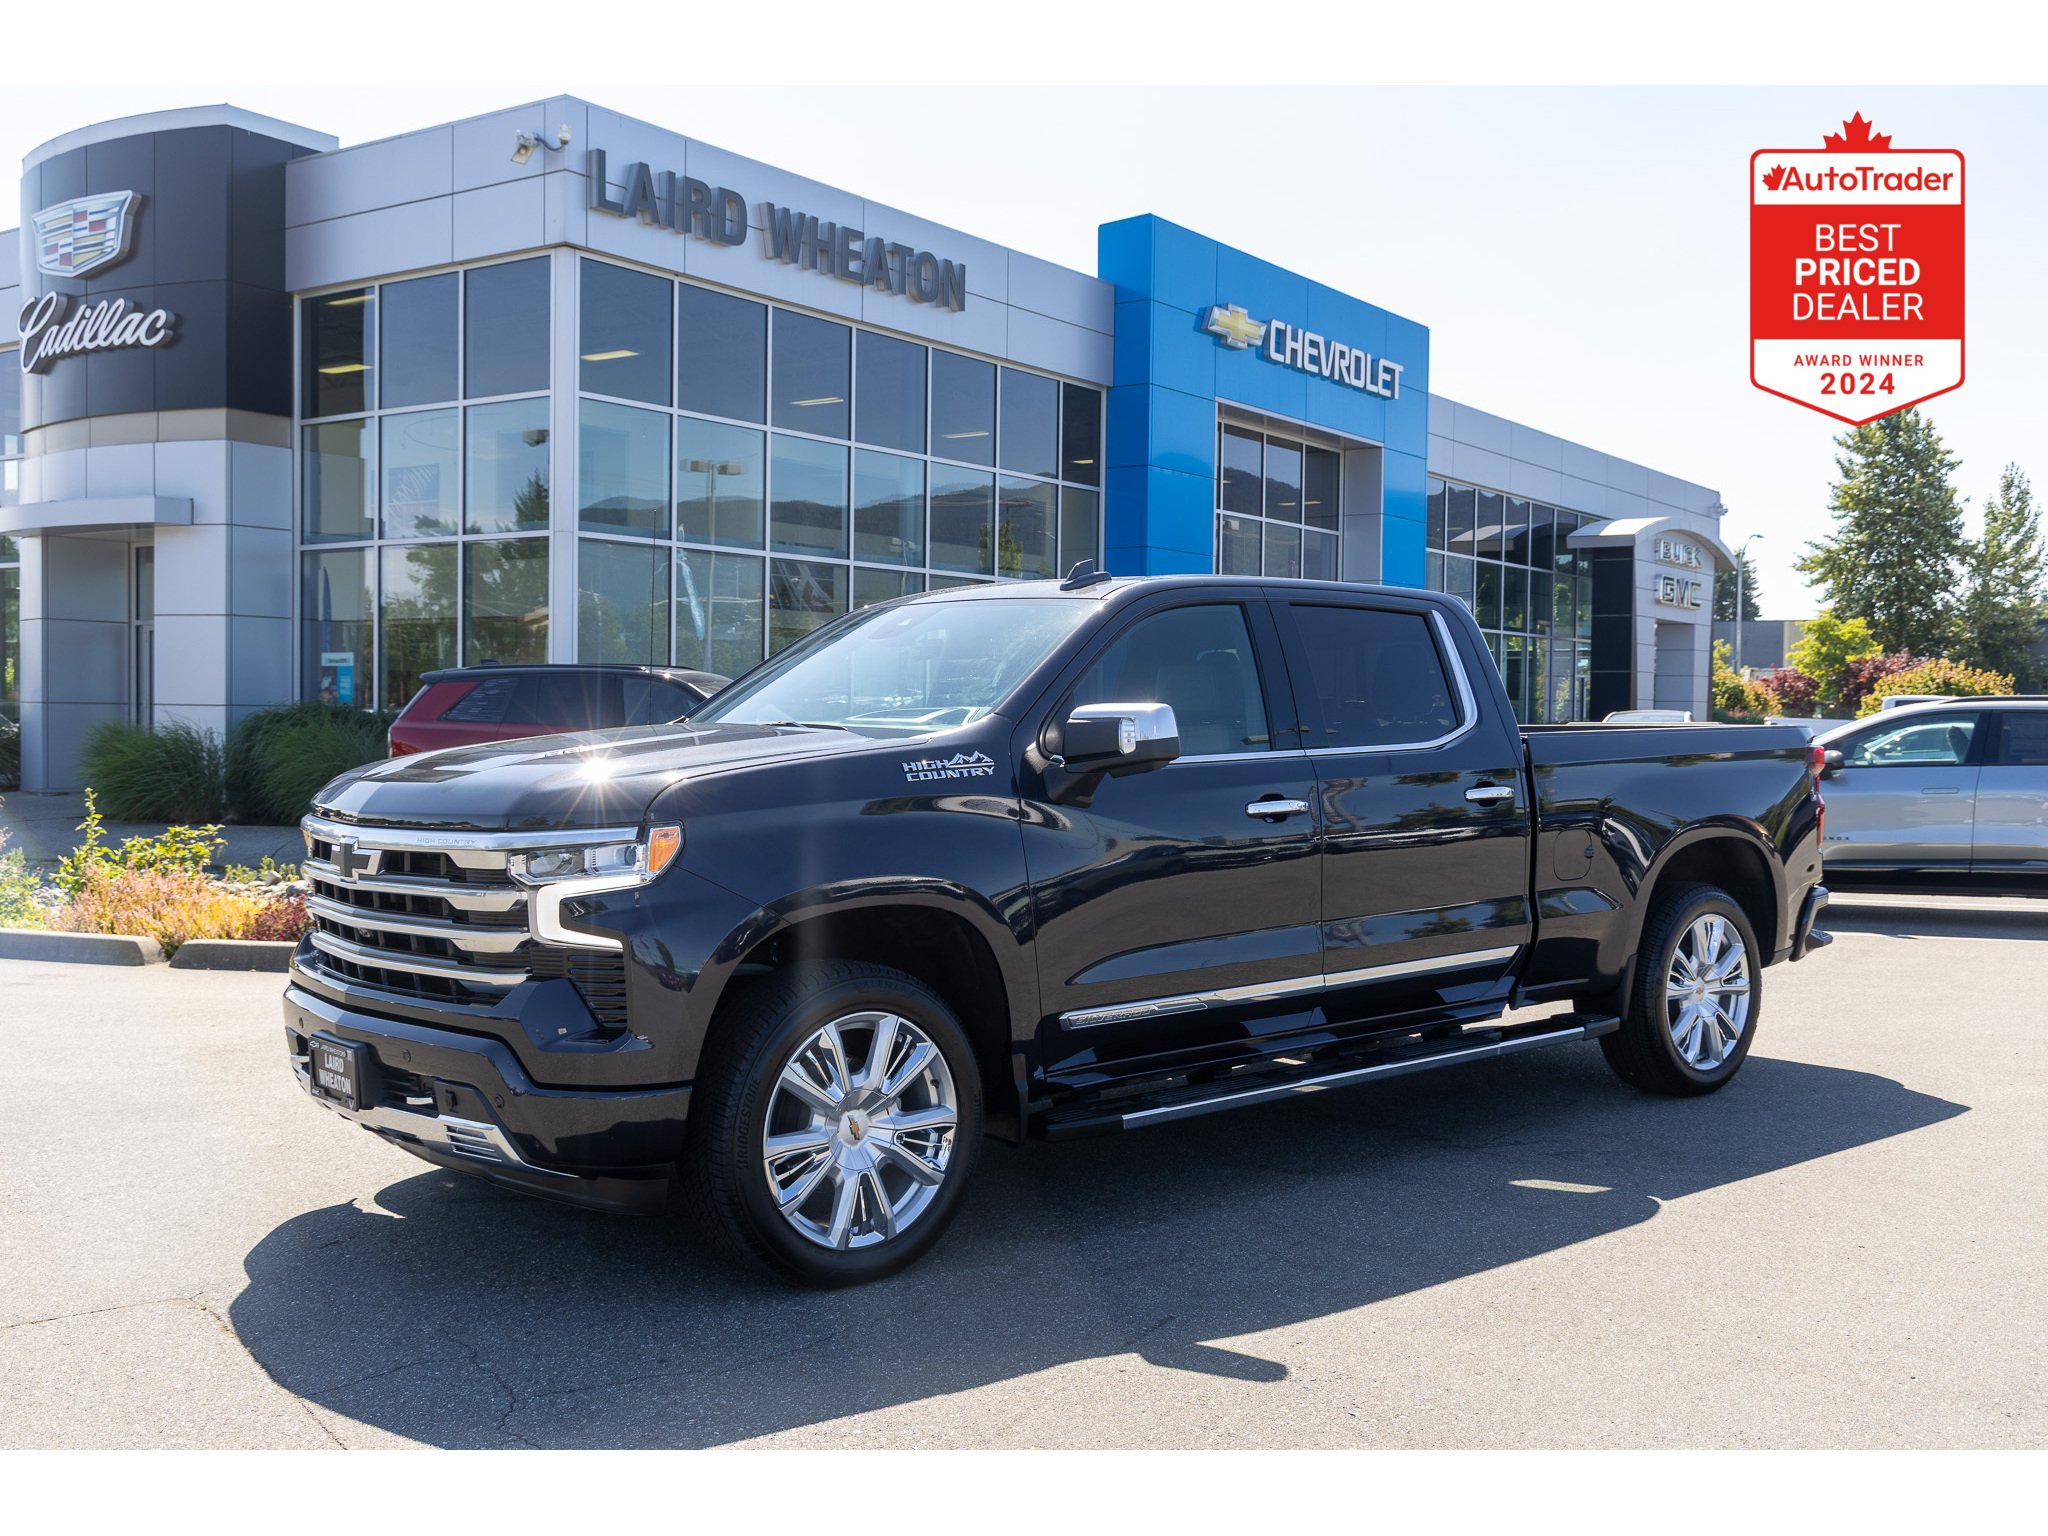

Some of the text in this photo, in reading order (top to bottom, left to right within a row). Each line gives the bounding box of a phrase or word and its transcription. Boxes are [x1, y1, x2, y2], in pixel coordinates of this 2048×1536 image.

[589, 149, 966, 312] LAIRD WHEATON
[17, 290, 172, 374] Cadillac
[1267, 318, 1404, 400] CHEVROLET
[1657, 539, 1702, 569] BUICK
[1657, 573, 1703, 609] GMC
[901, 759, 949, 772] HIGH
[906, 766, 995, 782] COUNTRY
[1076, 1008, 1152, 1025] SILVERADO
[324, 1053, 344, 1073] LAIRD
[318, 1069, 352, 1095] WHEATON
[736, 1077, 761, 1170] BRIDGESTONE
